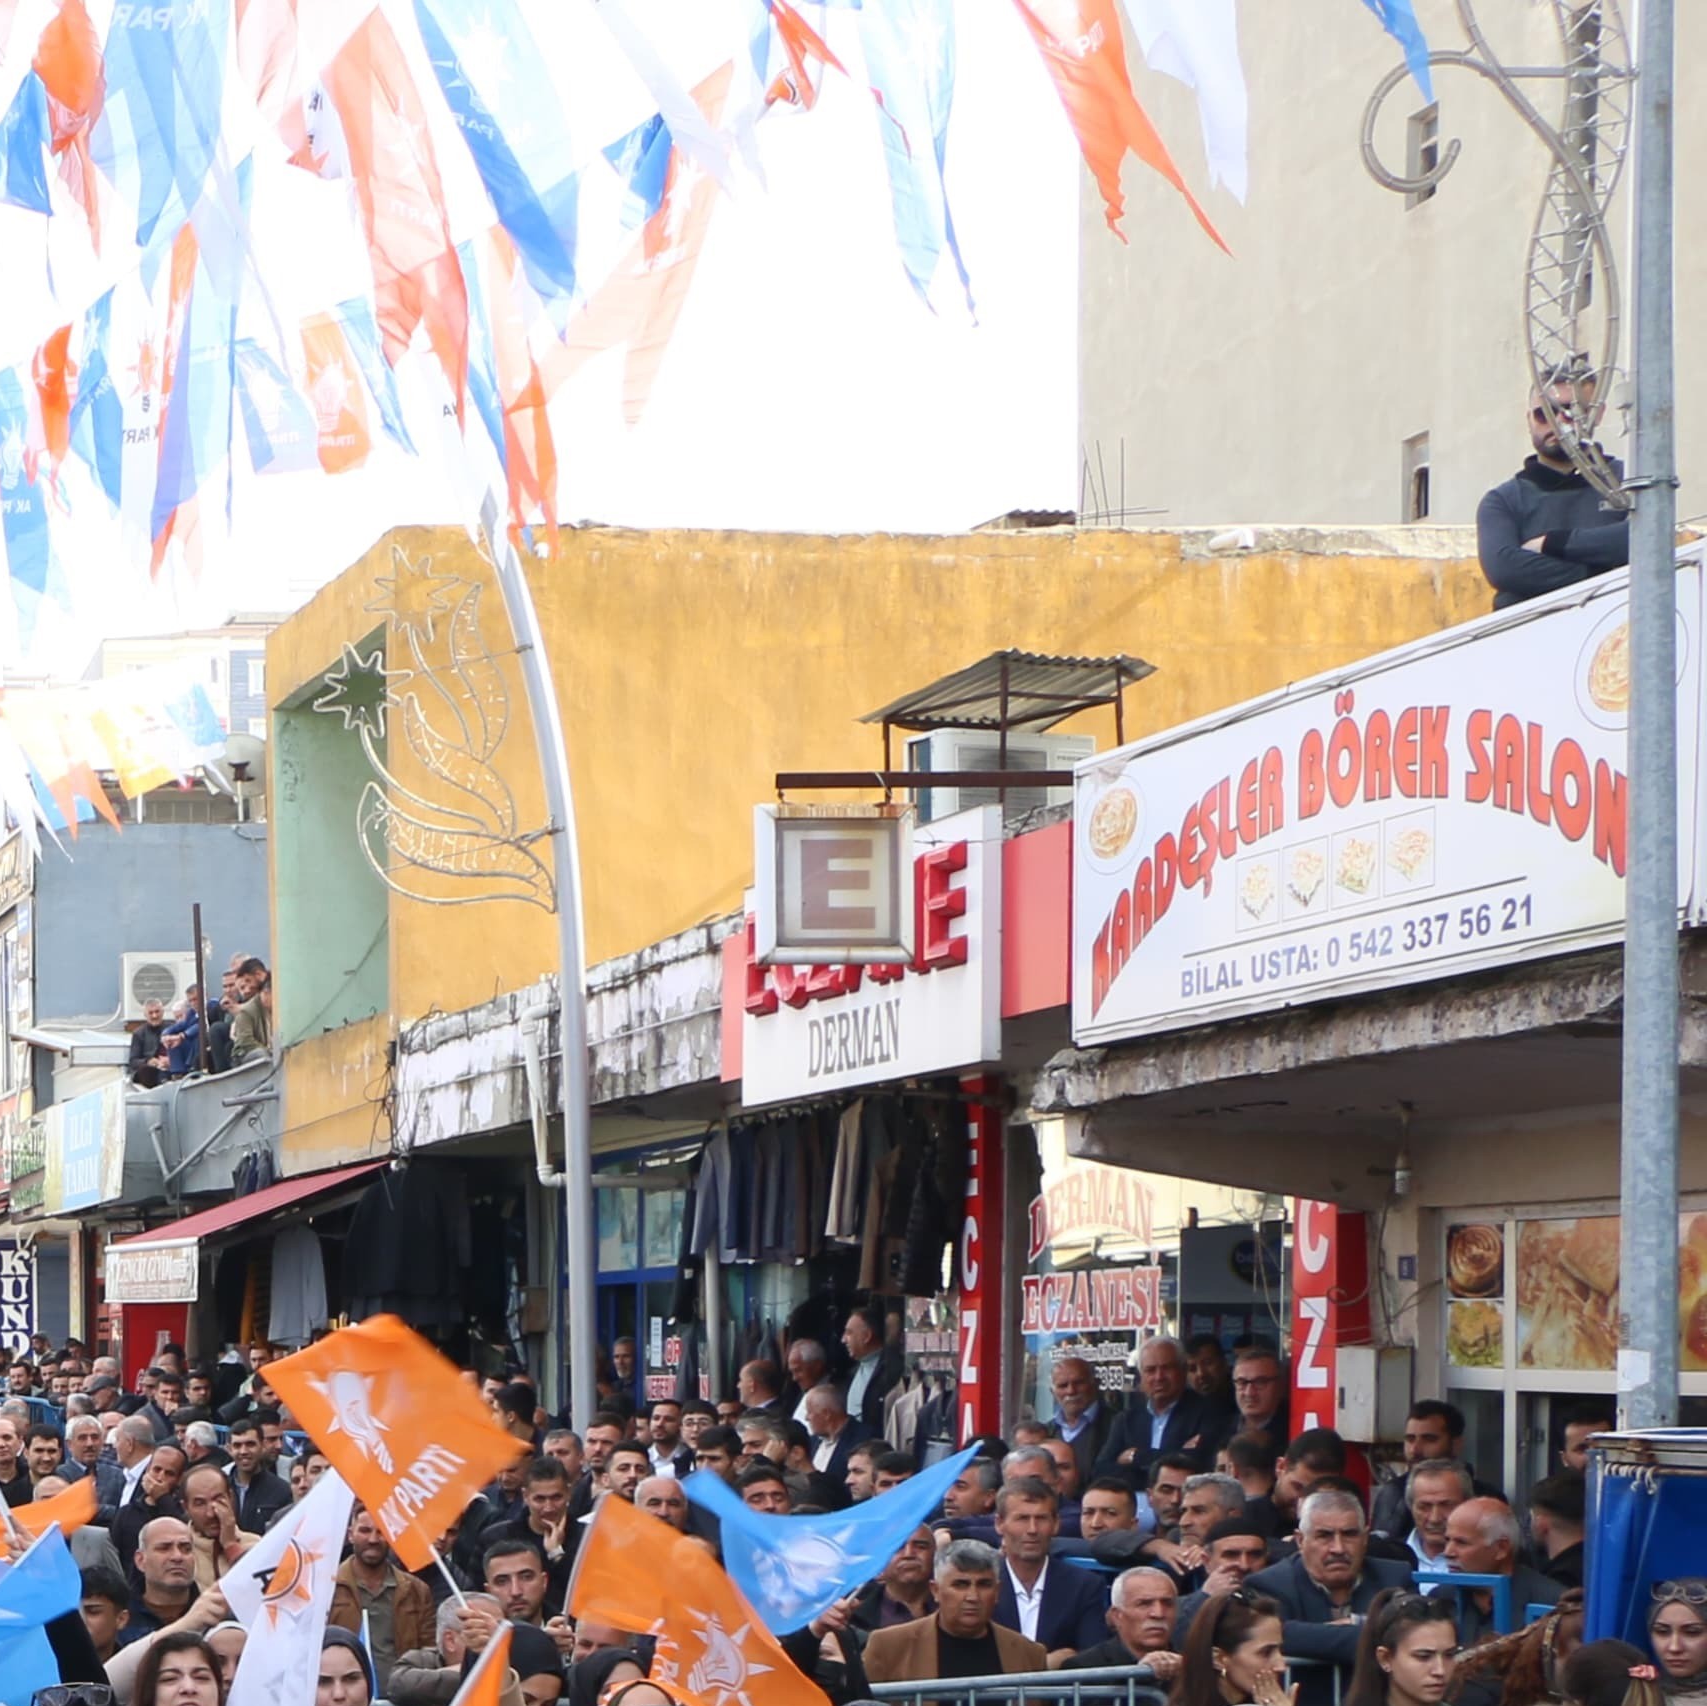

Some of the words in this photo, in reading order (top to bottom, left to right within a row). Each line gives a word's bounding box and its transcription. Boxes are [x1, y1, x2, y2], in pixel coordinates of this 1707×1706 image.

[801, 839, 875, 929] E
[1092, 745, 1284, 1021] KARDEŞLER
[1298, 689, 1451, 821] BÖREK
[1181, 957, 1244, 998] BİLAL
[1251, 944, 1319, 984] USTA:
[1327, 936, 1340, 967] 0
[1349, 925, 1394, 962] 542
[1402, 912, 1449, 951] 337
[1459, 903, 1492, 939] 56
[1501, 893, 1534, 931] 21
[808, 1000, 901, 1077] DERMAN
[1027, 1166, 1154, 1264] DERMAN
[1295, 1199, 1330, 1432] CZ
